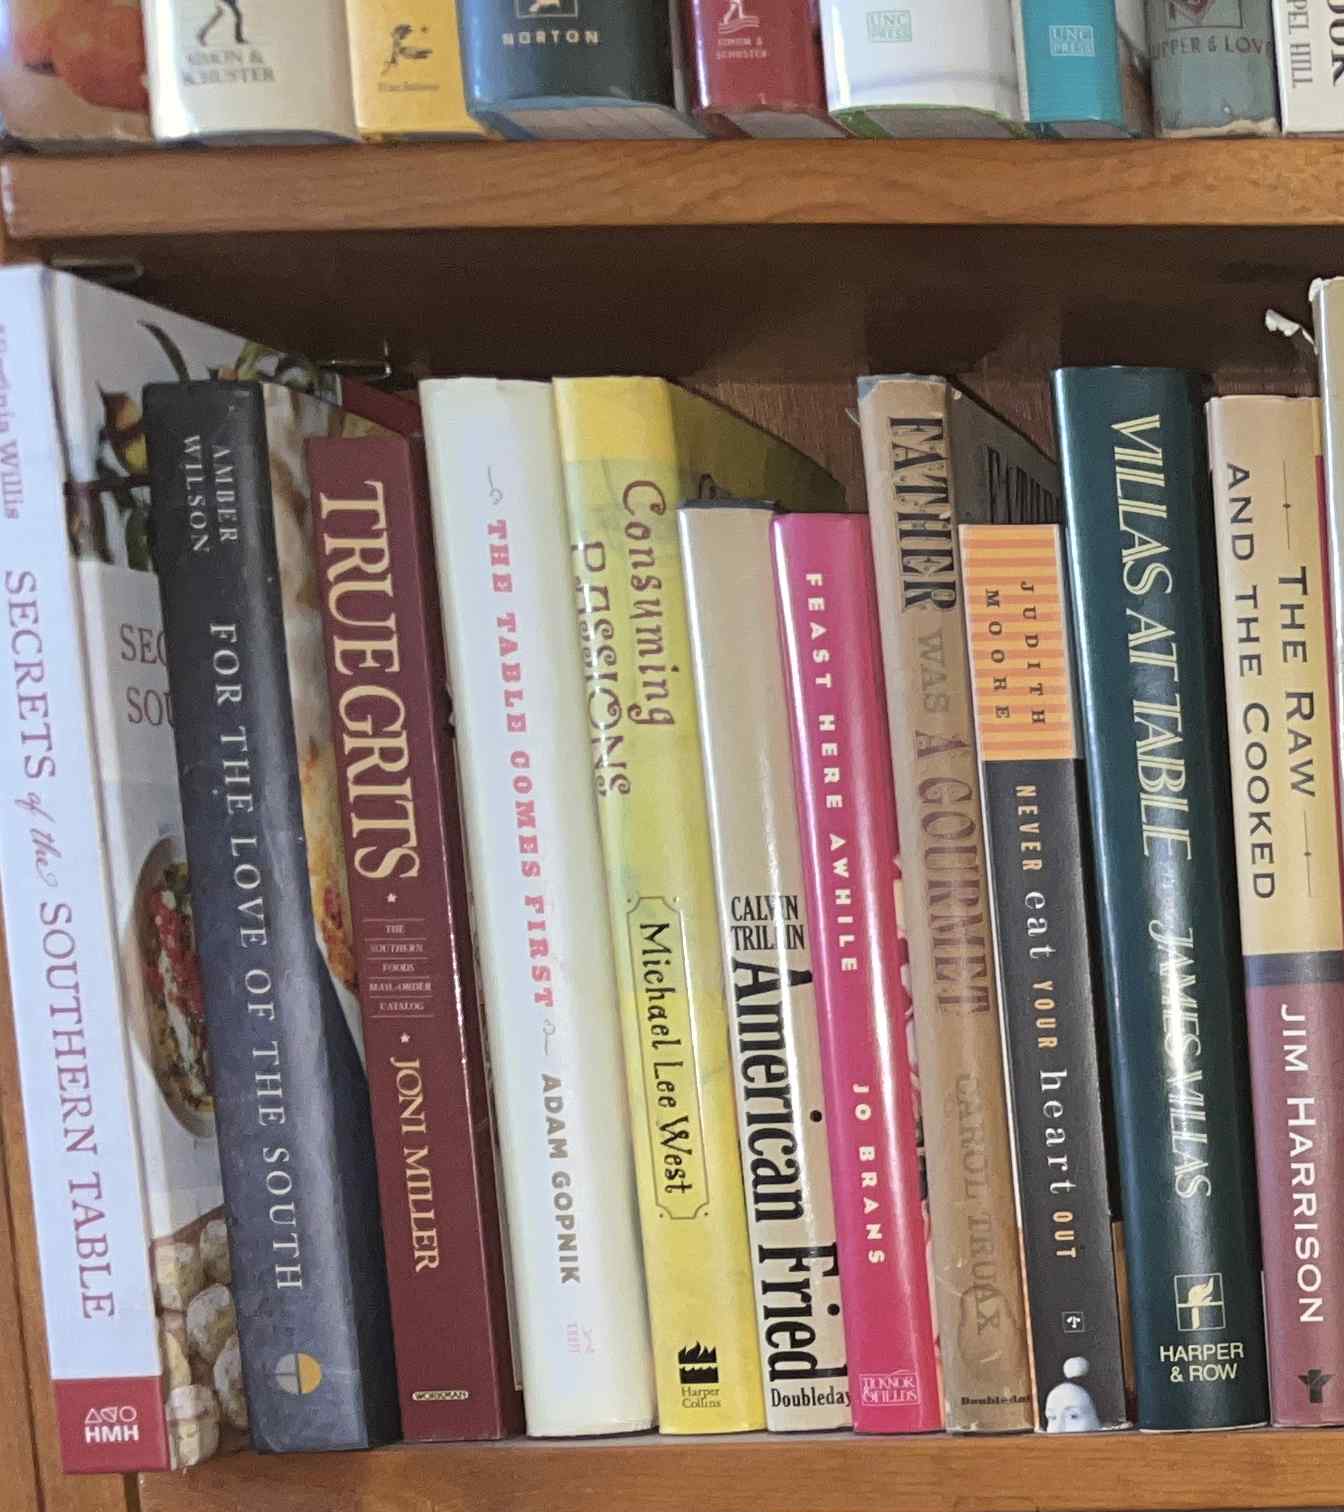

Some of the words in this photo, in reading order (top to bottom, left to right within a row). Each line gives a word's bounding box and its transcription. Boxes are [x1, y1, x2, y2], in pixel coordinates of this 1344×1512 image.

[501, 29, 600, 46] NORTON
[182, 433, 210, 554] WILSON
[211, 443, 240, 544] AMBER
[1226, 462, 1257, 563] AND
[319, 479, 402, 677] TRUE
[487, 519, 514, 594] THE
[209, 621, 243, 707] FOR
[805, 572, 833, 690] FEAST
[1233, 585, 1264, 679] THE
[1277, 565, 1310, 665] THE
[4, 568, 57, 779] SECRETS
[496, 612, 528, 734] TABLE
[219, 724, 258, 817] THE
[337, 684, 421, 880] GRITS
[817, 712, 845, 811] HERE
[1283, 689, 1318, 800] RAW
[508, 750, 543, 880] COMES
[1014, 783, 1043, 873] NEVER
[1240, 702, 1277, 900] COOKED
[229, 835, 268, 948] LOVE
[827, 833, 859, 973] AWHILE
[1024, 889, 1057, 961] eat
[243, 967, 276, 1023] OF
[524, 894, 554, 1009] FIRST
[638, 921, 680, 1049] Michael
[38, 900, 104, 1156] SOUTHERN
[1032, 979, 1059, 1050] YOUR
[1279, 1002, 1310, 1074] JIM
[251, 1040, 286, 1128] THE
[390, 1055, 428, 1135] JONI
[653, 1060, 687, 1110] Lee
[732, 957, 825, 1224] American
[852, 1083, 873, 1122] JO
[1038, 1069, 1077, 1196] heart
[656, 1114, 694, 1196] West
[69, 1170, 117, 1321] TABLE
[259, 1145, 304, 1292] SOUTH
[402, 1146, 441, 1274] MILLER
[857, 1146, 886, 1266] BRANS
[1051, 1210, 1078, 1261] OUT
[1284, 1095, 1326, 1325] HARRISON
[757, 1240, 849, 1384] Fried
[1159, 1341, 1245, 1364] HARPER
[1169, 1366, 1185, 1383] &
[1188, 1363, 1239, 1382] ROW
[84, 1424, 140, 1444] HMH
